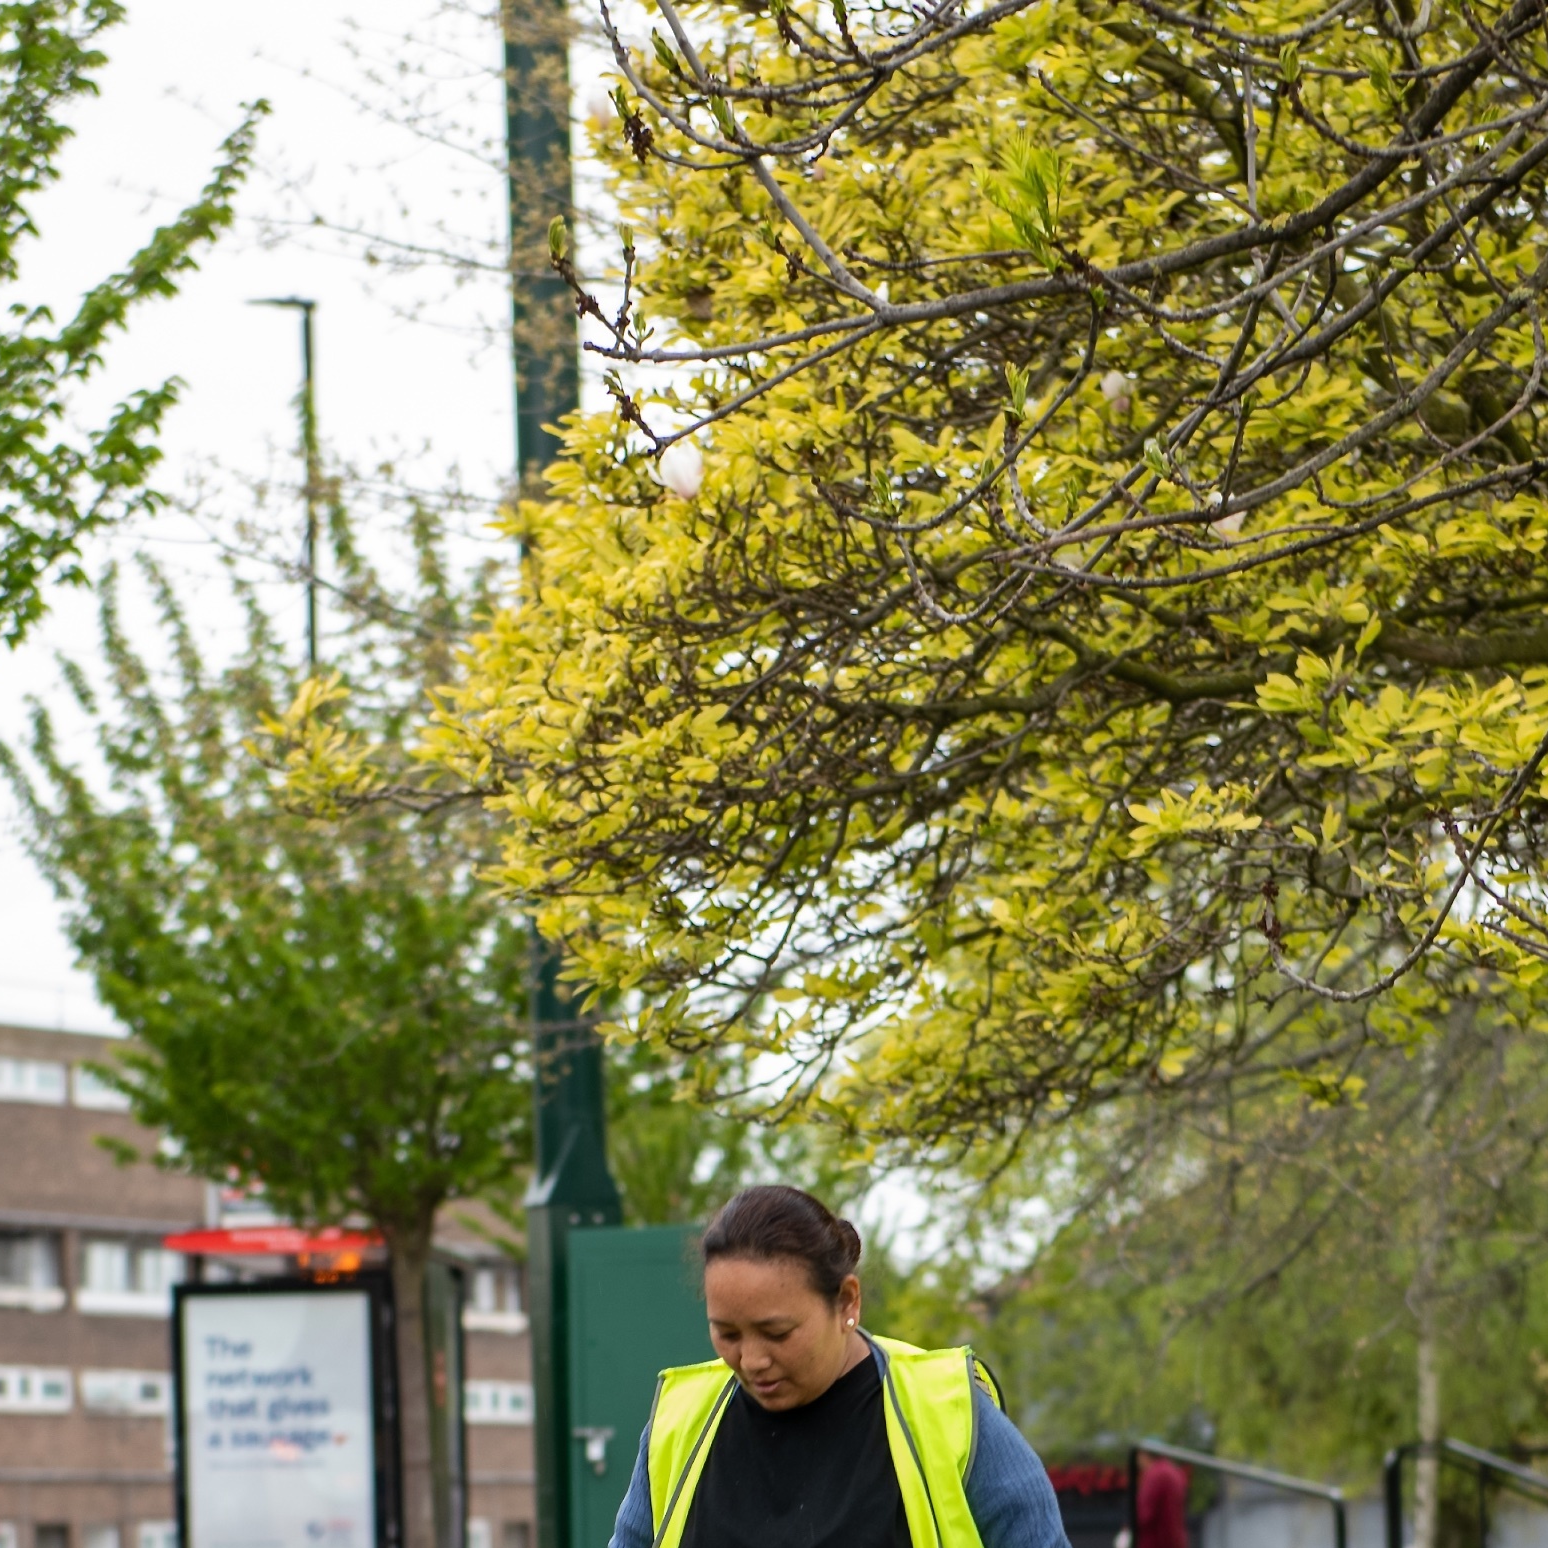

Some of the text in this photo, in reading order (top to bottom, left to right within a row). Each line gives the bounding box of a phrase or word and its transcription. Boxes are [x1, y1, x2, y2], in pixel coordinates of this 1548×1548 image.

[205, 1335, 251, 1359] The
[206, 1366, 312, 1390] network
[208, 1397, 331, 1424] that gives
